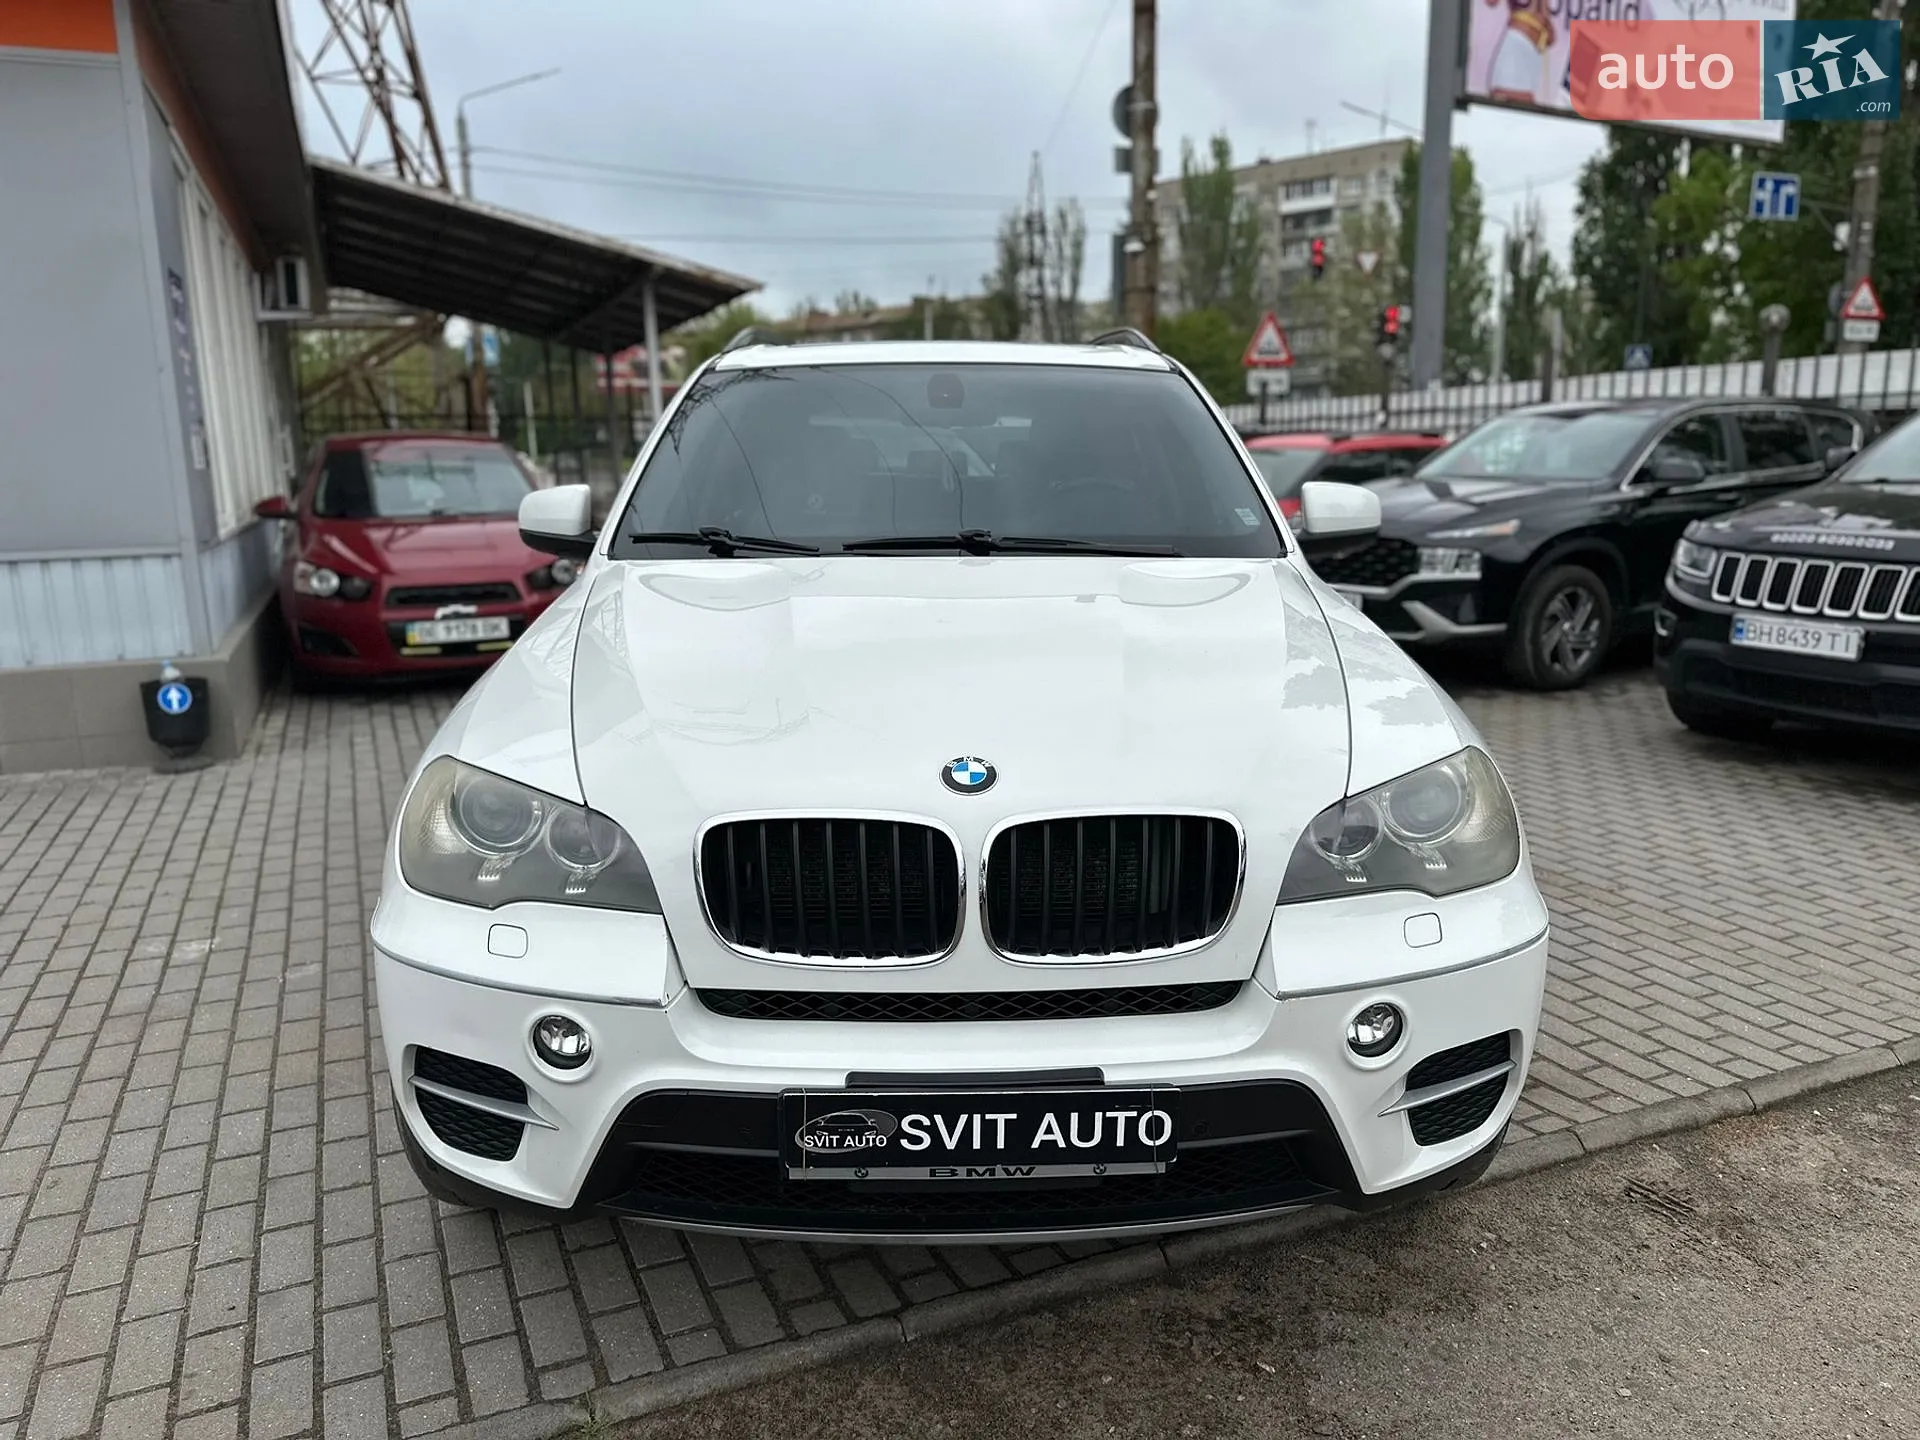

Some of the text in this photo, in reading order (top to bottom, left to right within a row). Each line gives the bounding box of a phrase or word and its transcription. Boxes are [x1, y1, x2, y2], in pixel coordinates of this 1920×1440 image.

[1745, 623, 1851, 653] BH 8439 TI
[900, 1110, 1172, 1150] SVIT AUTO
[805, 1135, 887, 1148] SVIT AUTO
[928, 1166, 1036, 1178] BMW
